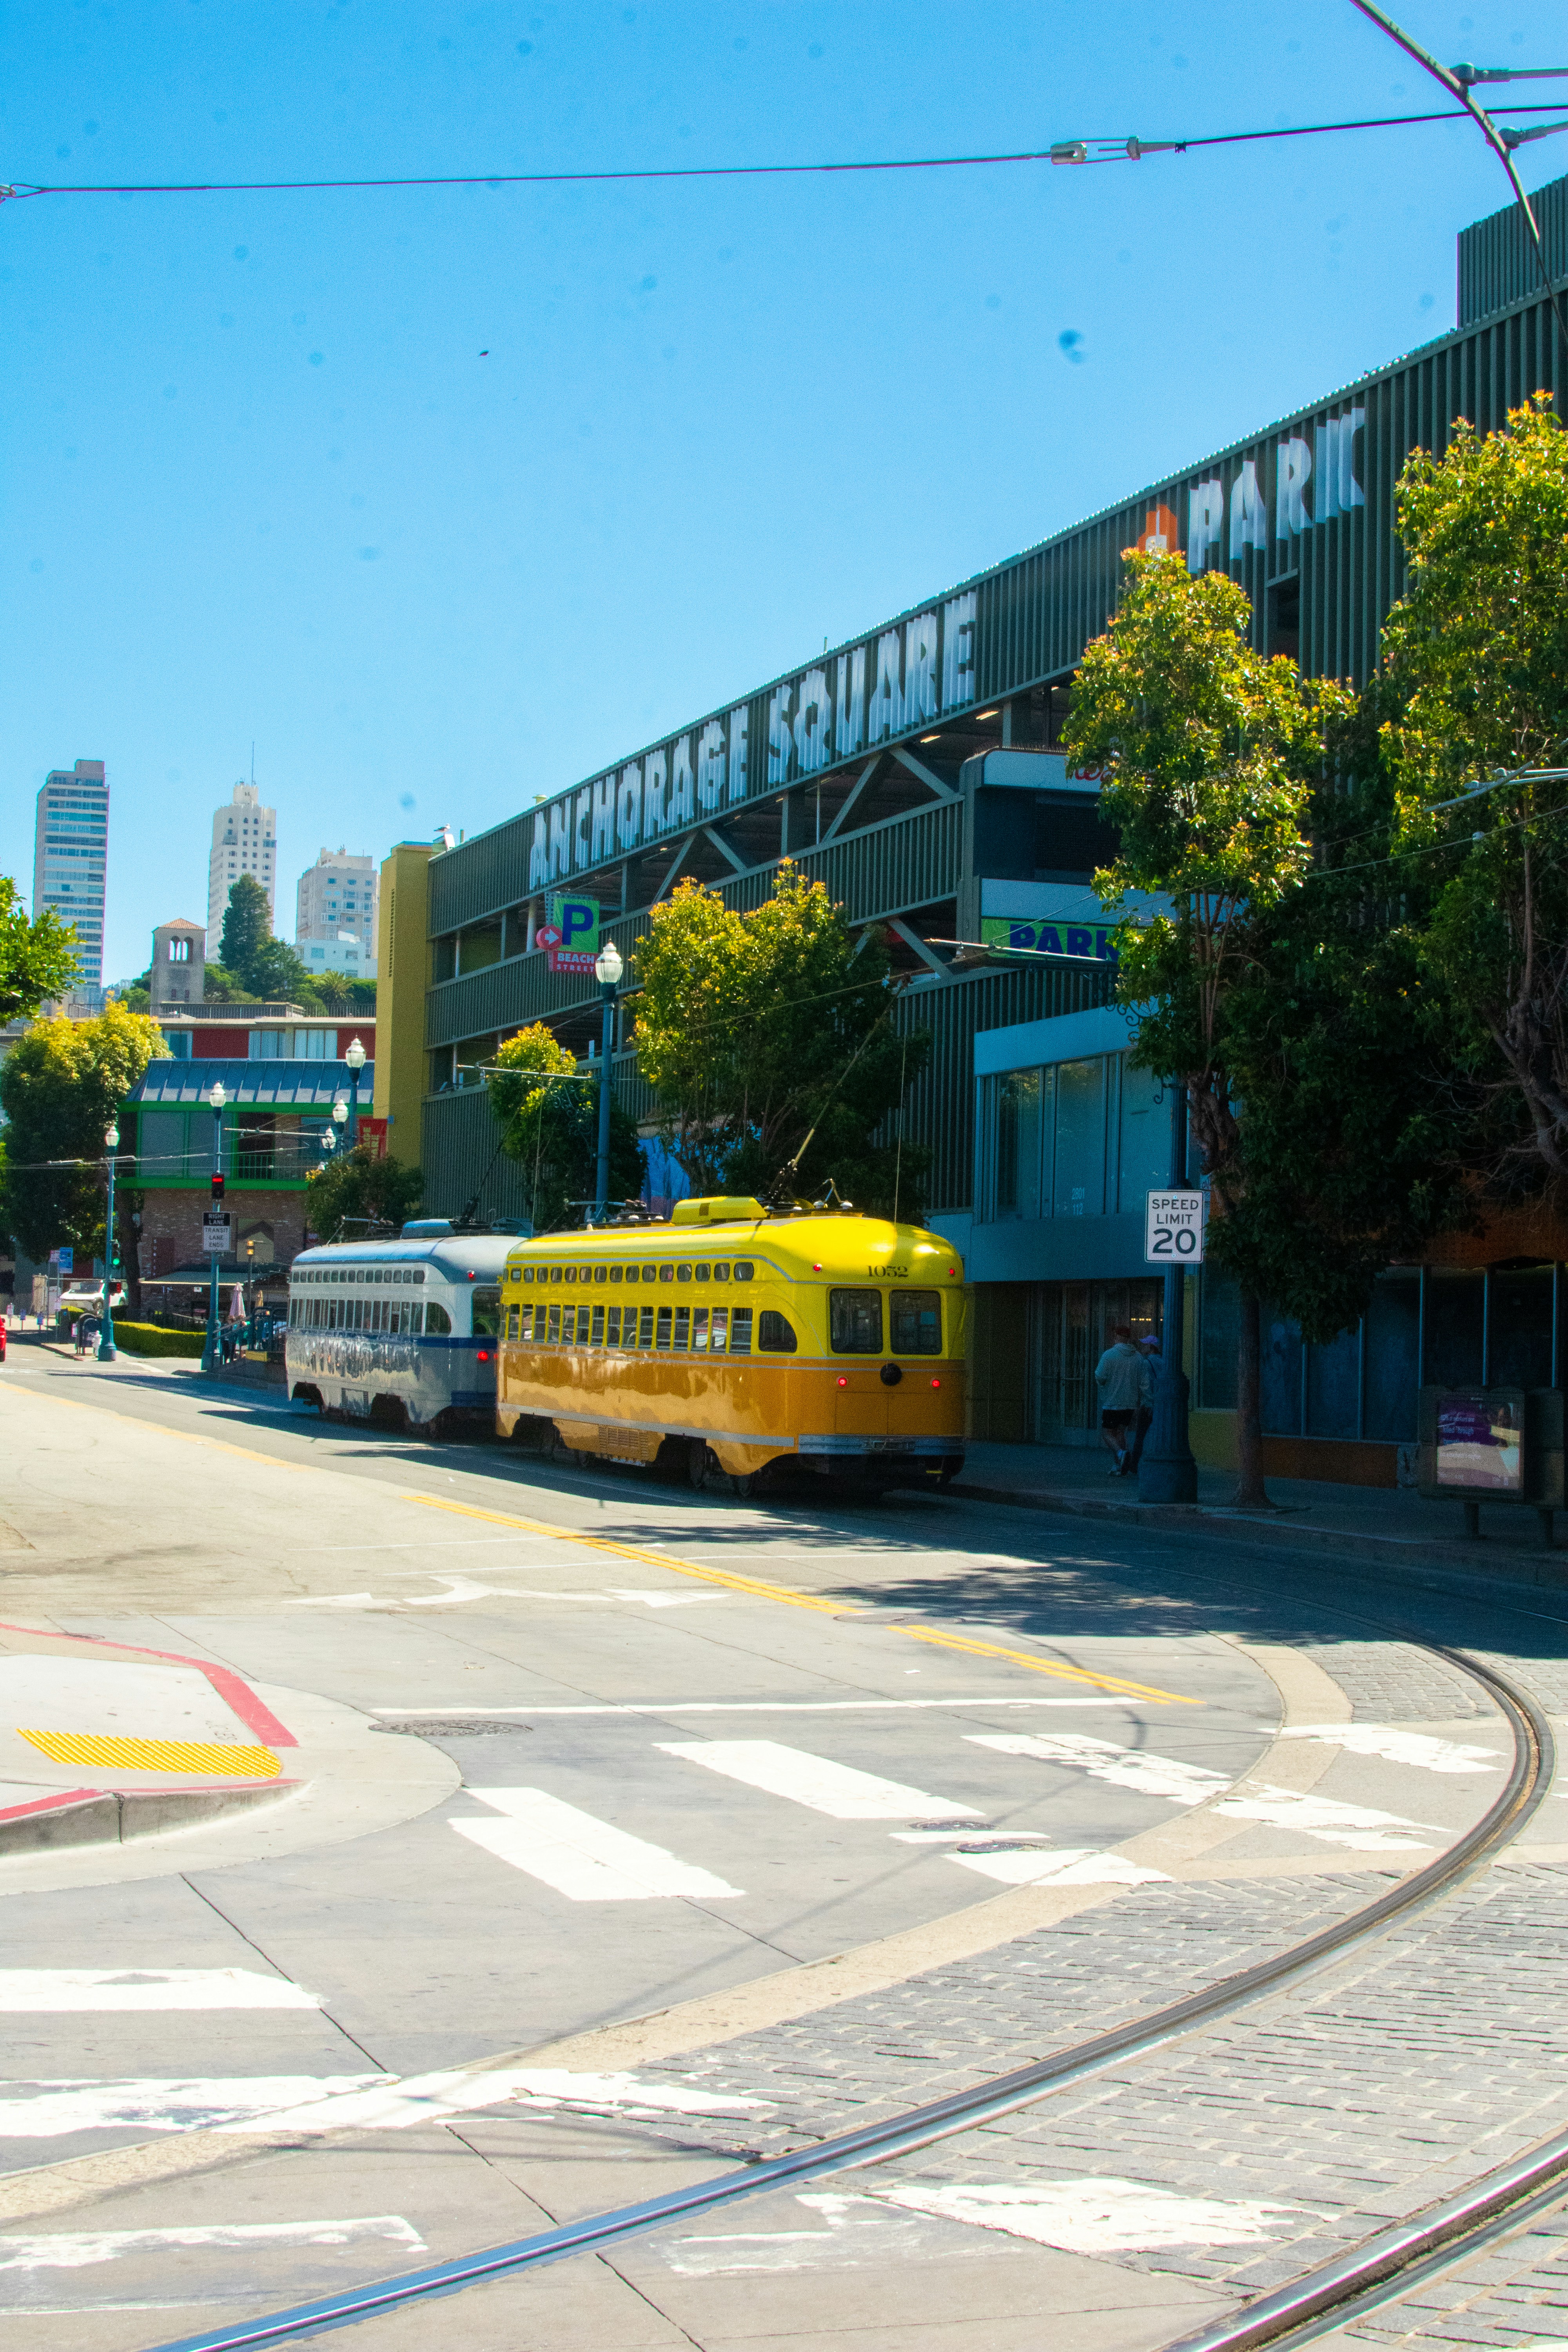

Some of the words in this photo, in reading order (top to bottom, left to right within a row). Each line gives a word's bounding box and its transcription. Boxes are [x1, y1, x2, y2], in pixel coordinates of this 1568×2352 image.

[1188, 408, 1365, 573] PARK
[530, 704, 748, 891] ANCHORAGE
[768, 591, 976, 783] SQUARE
[562, 904, 593, 946] P
[557, 953, 595, 964] BEACH
[1152, 1199, 1199, 1210] SPEED
[1156, 1213, 1193, 1224] LIMIT
[1152, 1228, 1196, 1254] 20
[867, 1265, 908, 1277] 1052
